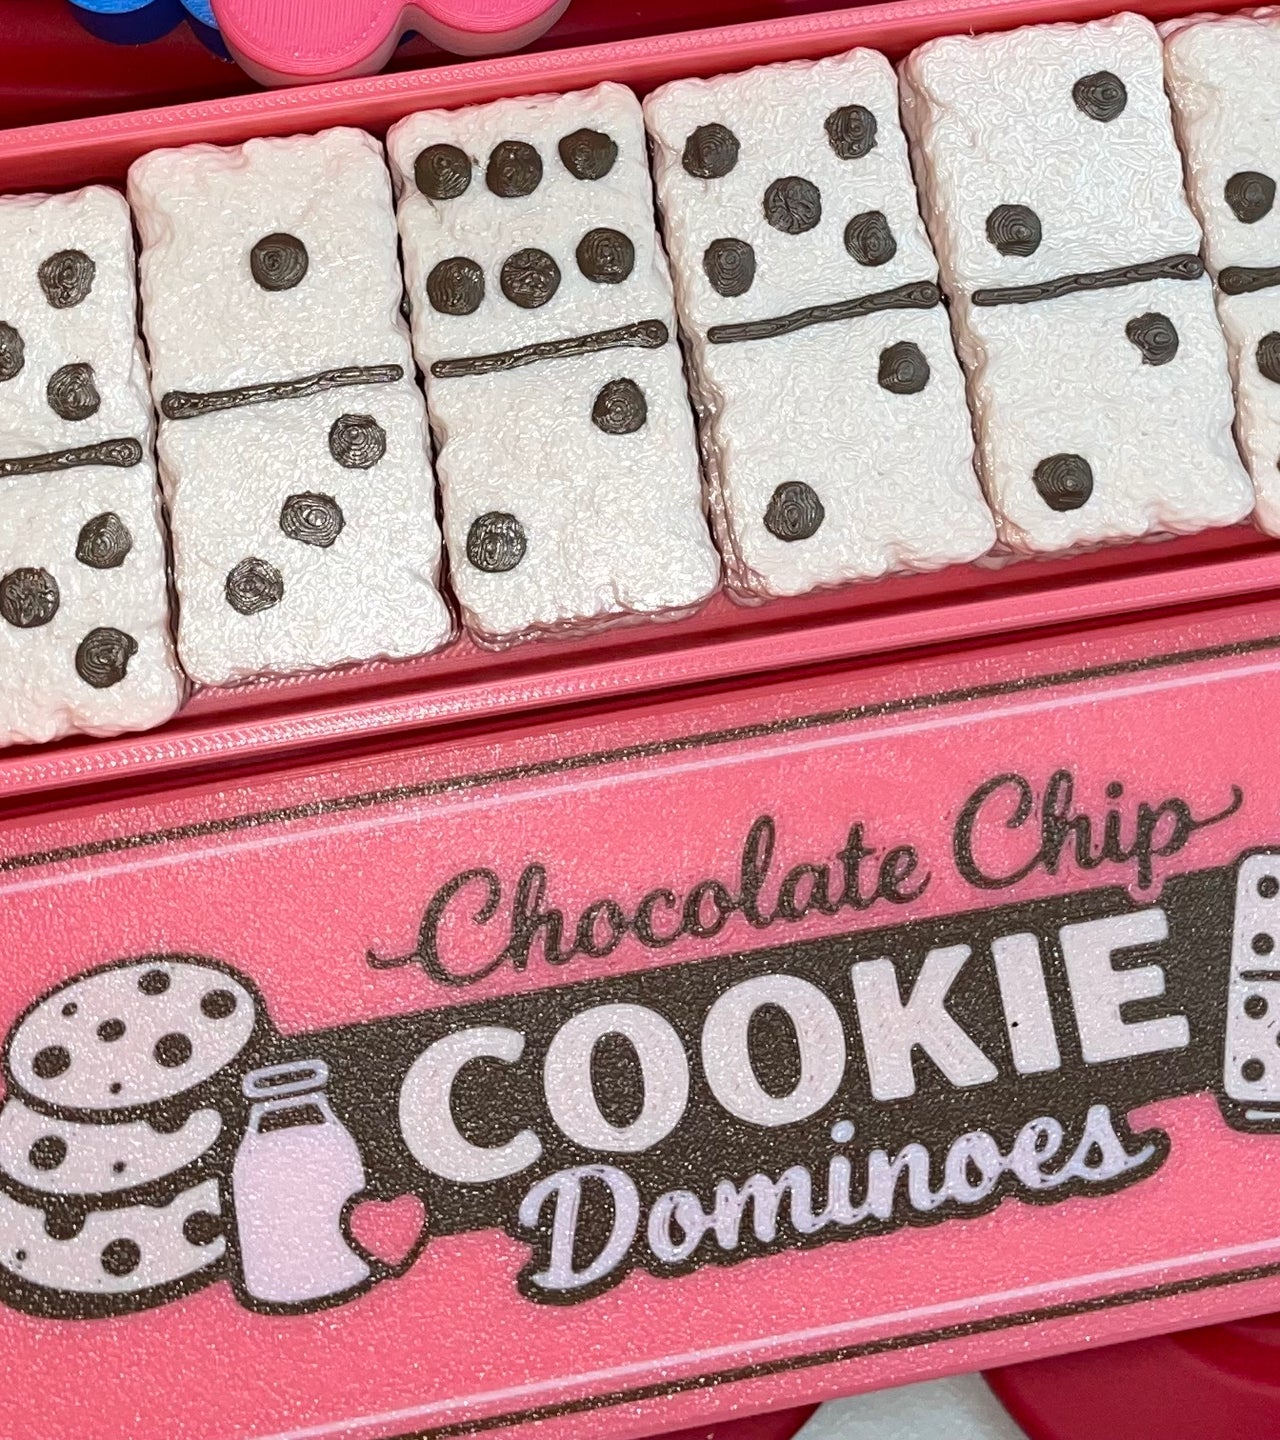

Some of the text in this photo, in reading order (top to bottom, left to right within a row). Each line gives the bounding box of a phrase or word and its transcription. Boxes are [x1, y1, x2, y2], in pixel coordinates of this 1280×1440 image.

[367, 770, 1243, 987] Chocolate Chip
[397, 907, 1191, 1183] COOKIE
[522, 1104, 1156, 1290] Dominoes
